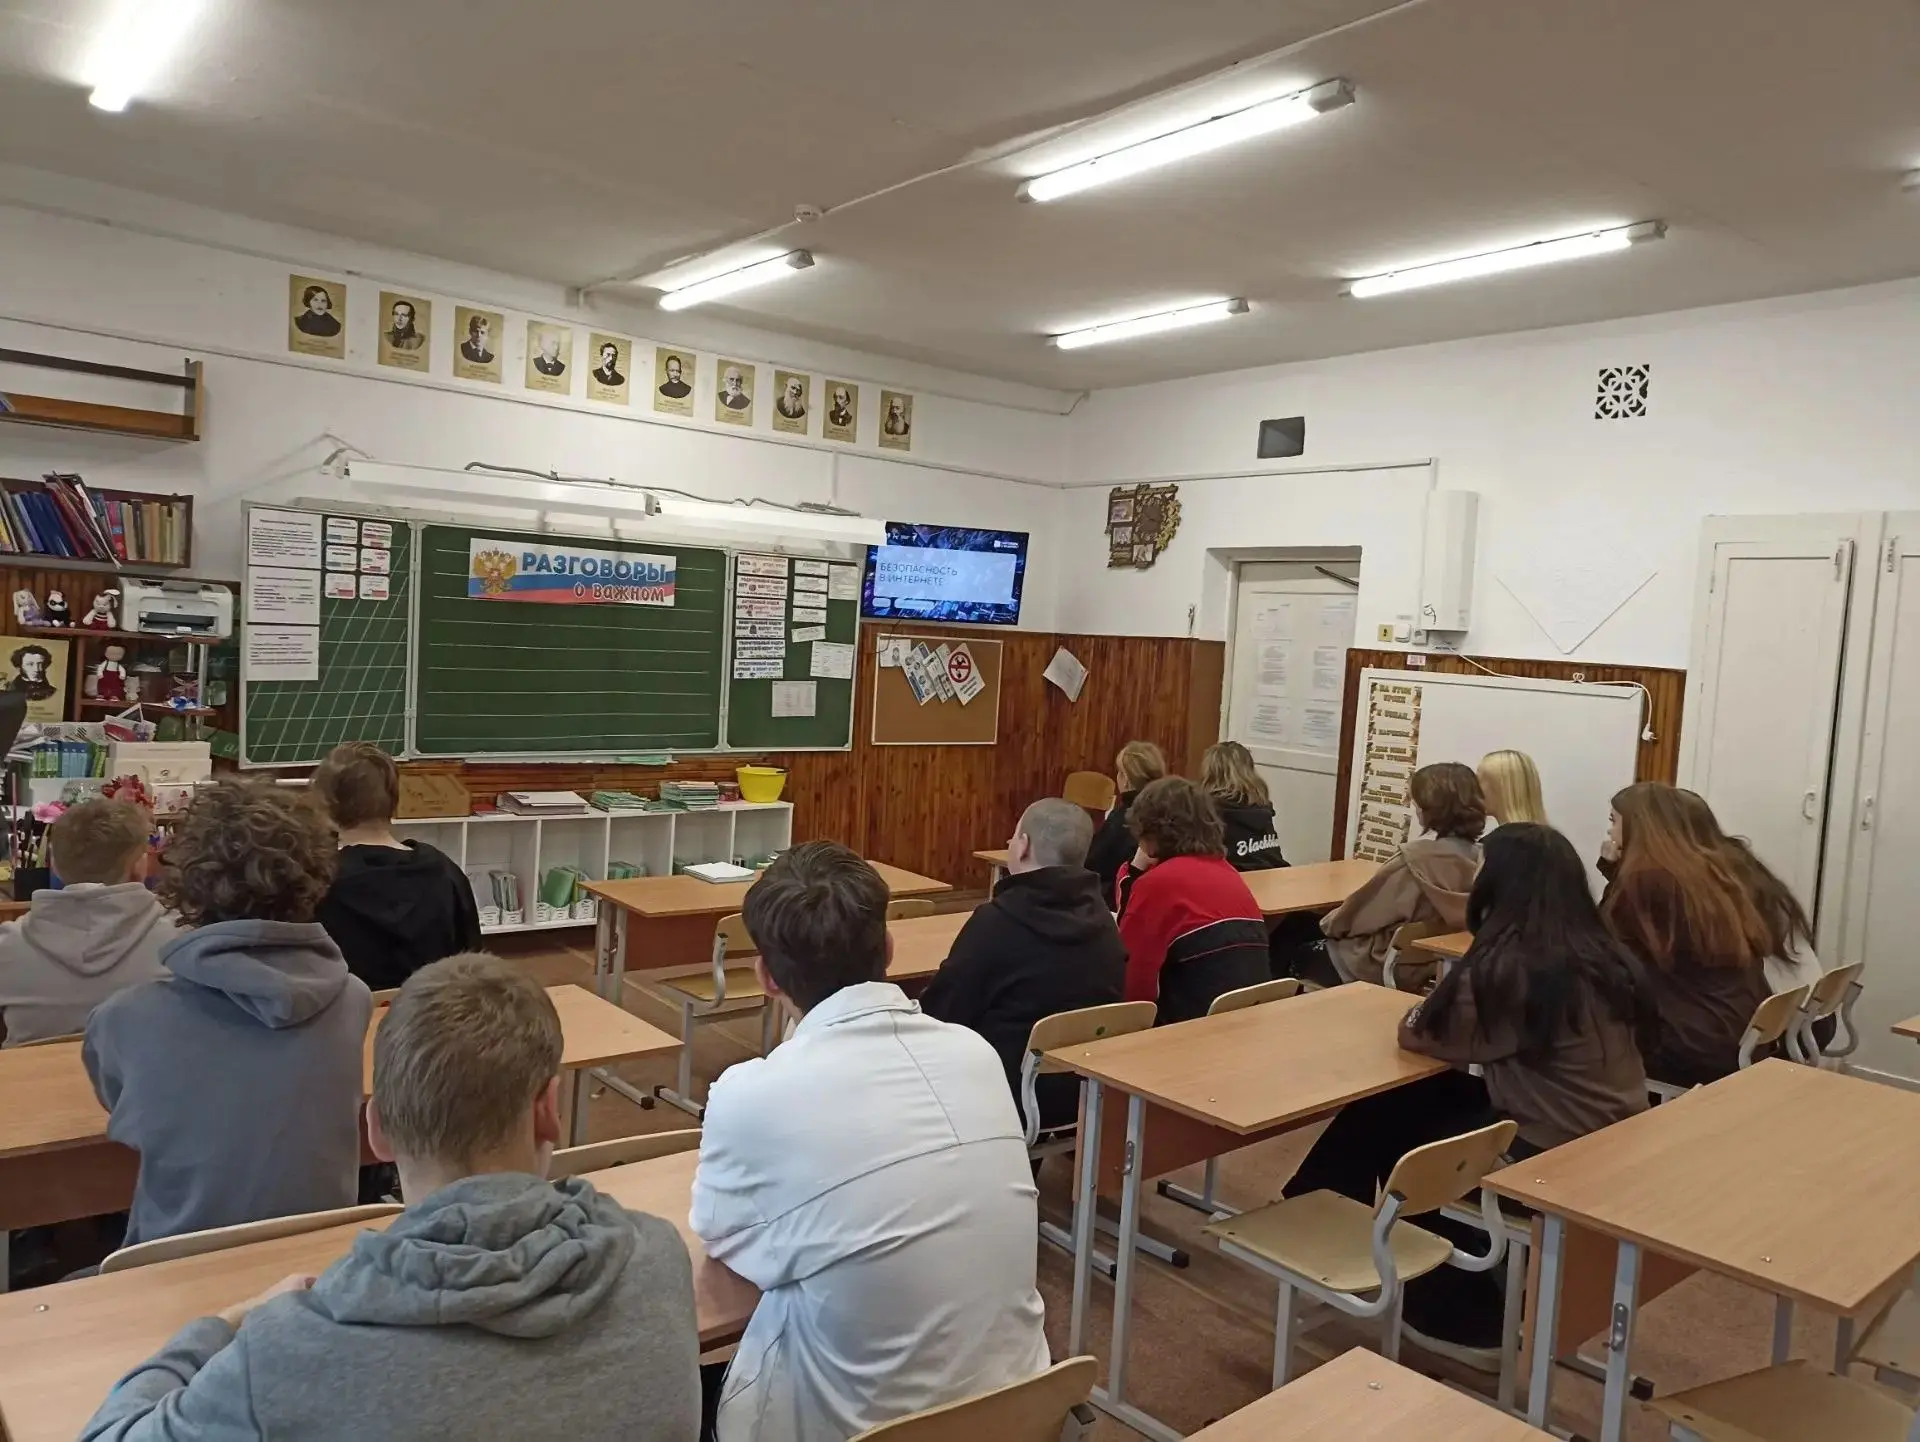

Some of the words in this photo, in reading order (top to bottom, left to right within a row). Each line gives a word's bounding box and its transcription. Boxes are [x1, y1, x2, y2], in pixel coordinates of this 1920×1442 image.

[522, 551, 666, 582] РАЗГОВОРЫ
[880, 562, 958, 576] БЕЗОПАСНОСТЬ
[879, 573, 886, 582] В
[887, 575, 945, 587] ИНТЕРНЕТЕ
[592, 583, 665, 603] важном
